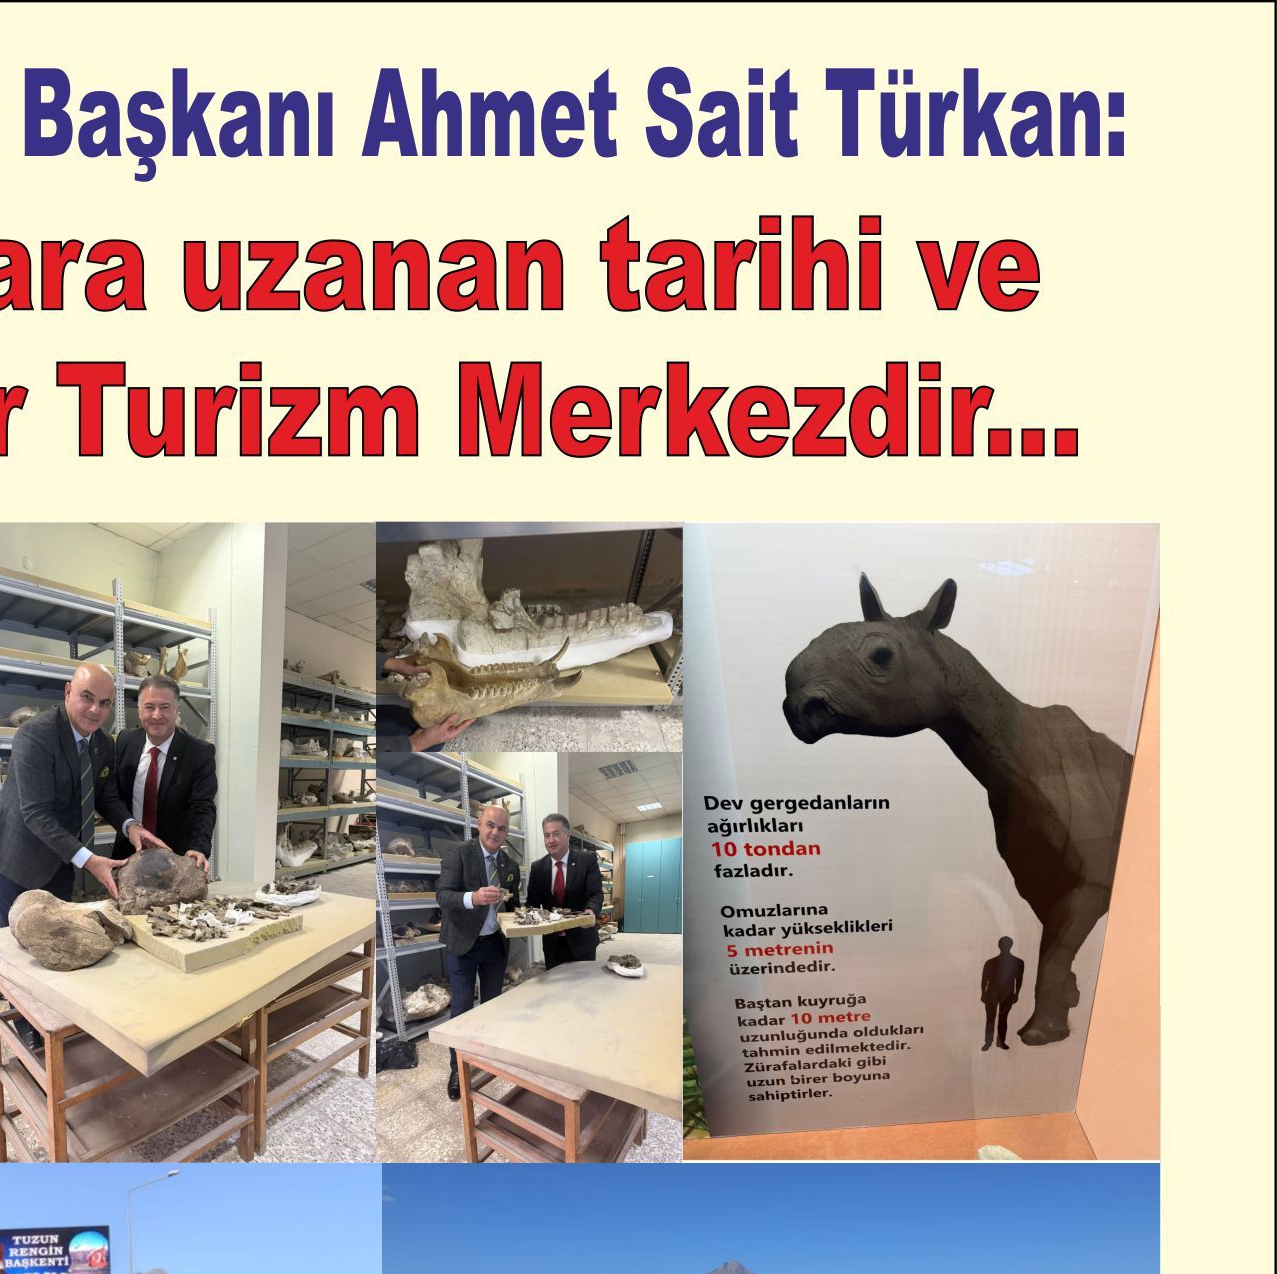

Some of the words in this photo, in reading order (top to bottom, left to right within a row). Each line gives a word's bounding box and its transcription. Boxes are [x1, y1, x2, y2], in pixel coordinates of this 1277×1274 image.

[703, 796, 743, 811] Dev
[750, 795, 890, 814] gergedanların
[707, 818, 803, 837] ağırlıkları
[711, 841, 737, 857] 10
[744, 840, 821, 857] tondan
[714, 863, 793, 878] fazladır.
[720, 904, 828, 918] Omuzlarına
[723, 924, 776, 937] kadar
[781, 919, 893, 939] yükseklikleri
[727, 944, 738, 957] 5
[745, 941, 834, 957] metrenin
[729, 960, 835, 976] üzerindedir.
[735, 998, 792, 1012] Baştan
[797, 994, 867, 1009] kuyruğa
[737, 1015, 786, 1027] kadar
[791, 1012, 812, 1025] 10
[818, 1011, 872, 1024] metre
[740, 1027, 848, 1043] uzunluğunda
[853, 1024, 924, 1039] oldukları
[742, 1045, 801, 1058] tahmin
[805, 1040, 911, 1055] edilmektedir.
[744, 1057, 852, 1073] Zürafalardaki
[856, 1056, 887, 1070] gibi
[746, 1077, 786, 1088] uzun
[790, 1073, 828, 1085] birer
[833, 1071, 891, 1085] boyuna
[748, 1088, 833, 1102] sahiptirler.
[12, 1235, 59, 1245] TUZUN
[9, 1246, 63, 1257] RENGİN
[4, 1256, 69, 1269] BAŞKENTİ
